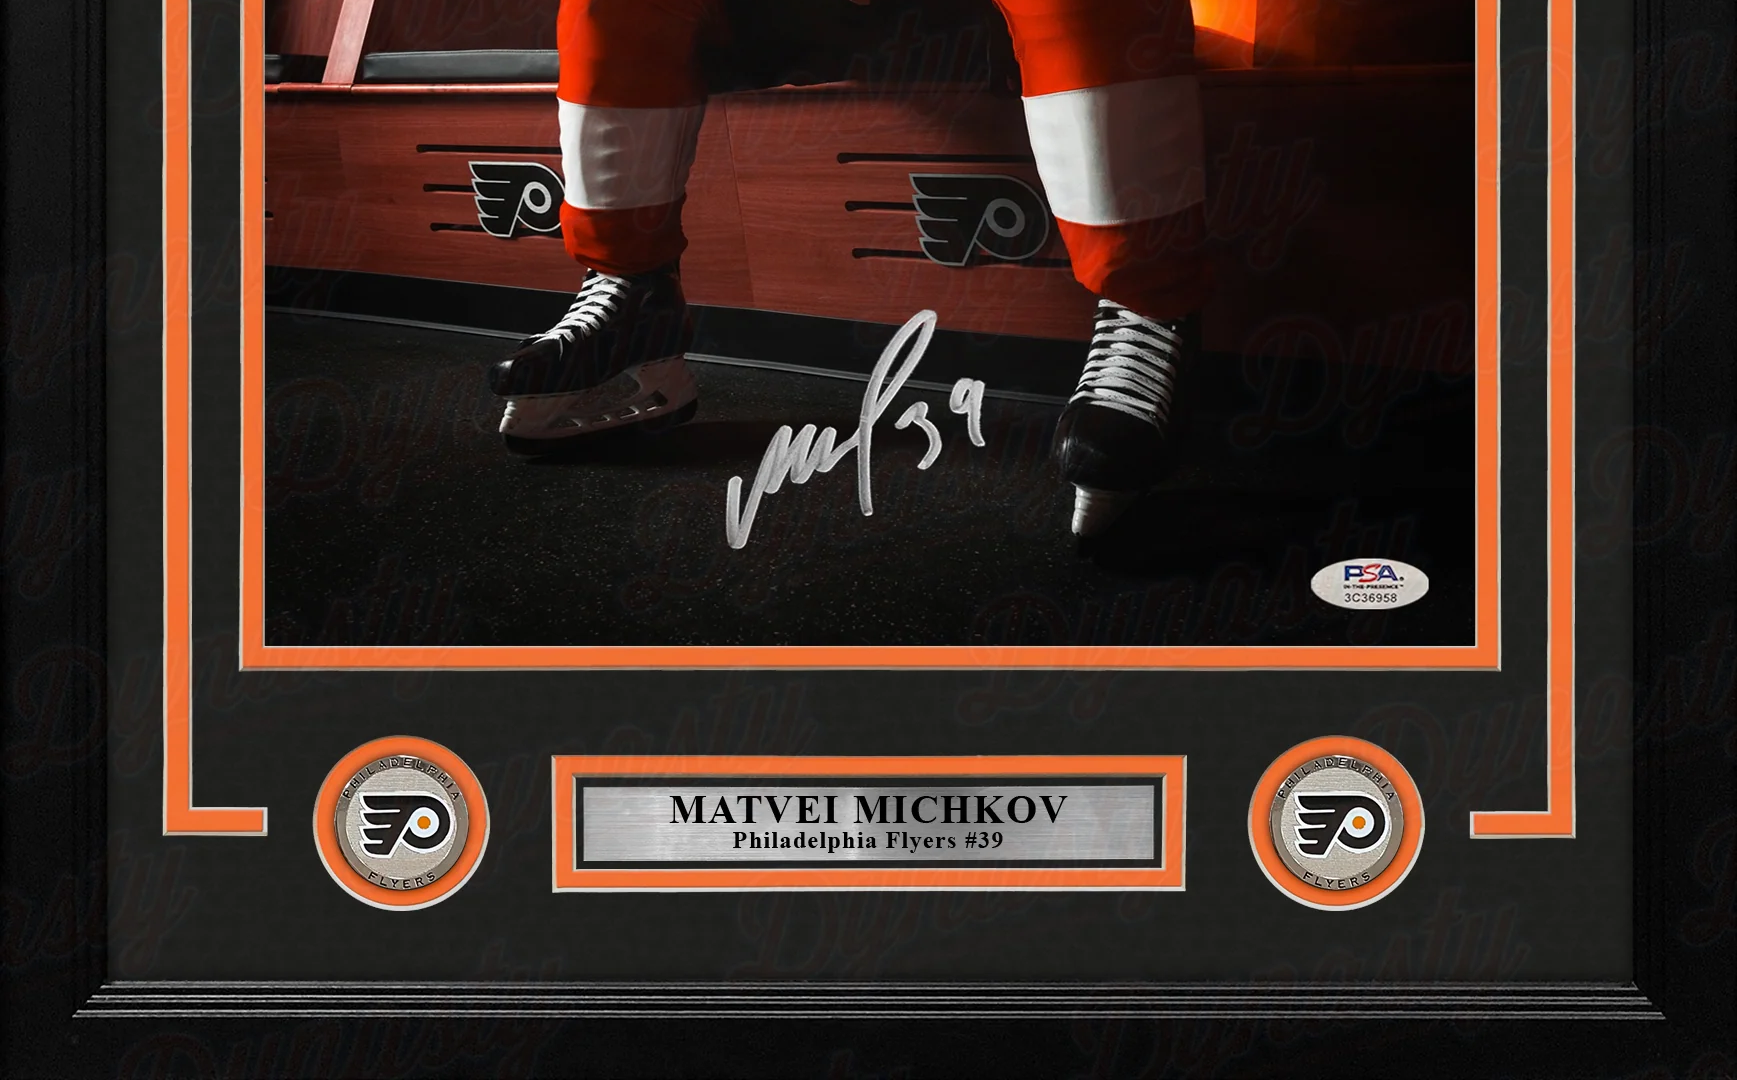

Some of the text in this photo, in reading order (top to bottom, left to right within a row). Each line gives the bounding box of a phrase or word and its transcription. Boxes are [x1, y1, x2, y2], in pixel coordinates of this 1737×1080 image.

[894, 377, 986, 470] 39
[1343, 563, 1399, 583] PSA
[1344, 593, 1398, 603] 3C36958
[342, 757, 461, 801] PHILADELPHIA
[1277, 757, 1396, 801] PHILADELPHIA
[669, 795, 1067, 824] MATVEI MICHKOV
[732, 831, 1003, 853] Philadelphia Flyers #39
[367, 871, 436, 889] FLYERS
[1302, 871, 1371, 889] FLYERS
